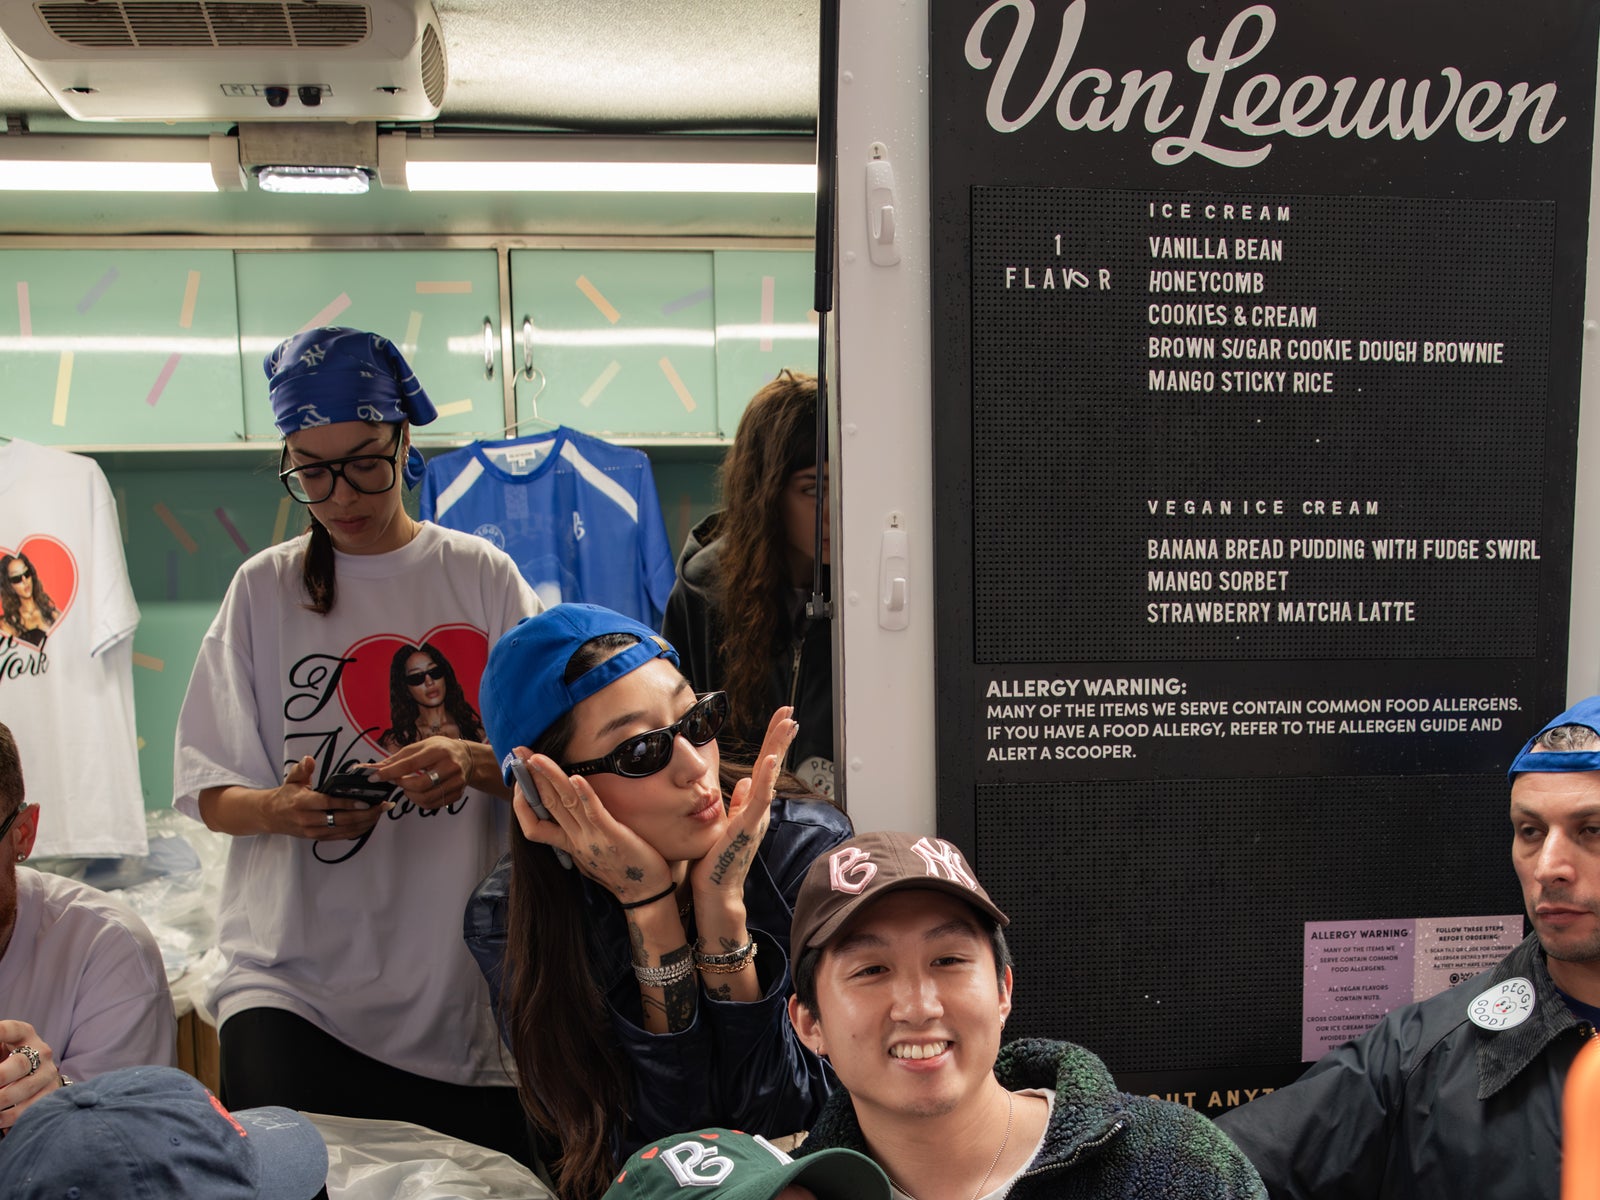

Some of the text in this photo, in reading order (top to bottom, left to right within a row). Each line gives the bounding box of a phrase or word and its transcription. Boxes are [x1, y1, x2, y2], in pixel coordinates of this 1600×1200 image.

[964, 0, 1567, 168] Van Leeuwen
[1149, 202, 1290, 222] ICE CREAM
[1054, 234, 1062, 256] 1
[1148, 236, 1283, 262] VANILLA BEAN
[1006, 267, 1111, 291] FLAVOR
[1149, 270, 1264, 294] HONEYCOMB
[1148, 303, 1317, 328] COOKIES & CREAM
[1148, 336, 1504, 364] BROWN SUGAR COOKIE DOUGH BROWNIE
[1148, 369, 1334, 394] MANGO STICKY RICE
[1147, 500, 1378, 516] VEGAN ICE CREAM
[1147, 538, 1541, 560] BANANA BREAD PUDDING WITH FUDGE SWIRL
[1147, 570, 1289, 592] MANGO SORBET
[1147, 601, 1416, 624] STRAWBERRY MATCHA LATTE
[985, 677, 1187, 698] ALLERGY WARNING:
[986, 697, 1522, 719] MANY OF THE ITEMS WE SERVE CONTAIN COMMON FOOD ALLERGENS.
[987, 717, 1502, 740] IF YOU HAVE A FOOD ALLERGY, REFER TO THE ALLERGEN GUIDE AND
[986, 744, 1137, 762] ALERT A SCOOPER.
[1311, 928, 1409, 940] ALLERGY WARNING
[1502, 982, 1531, 1011] PEGGY
[1474, 999, 1508, 1026] GOODS
